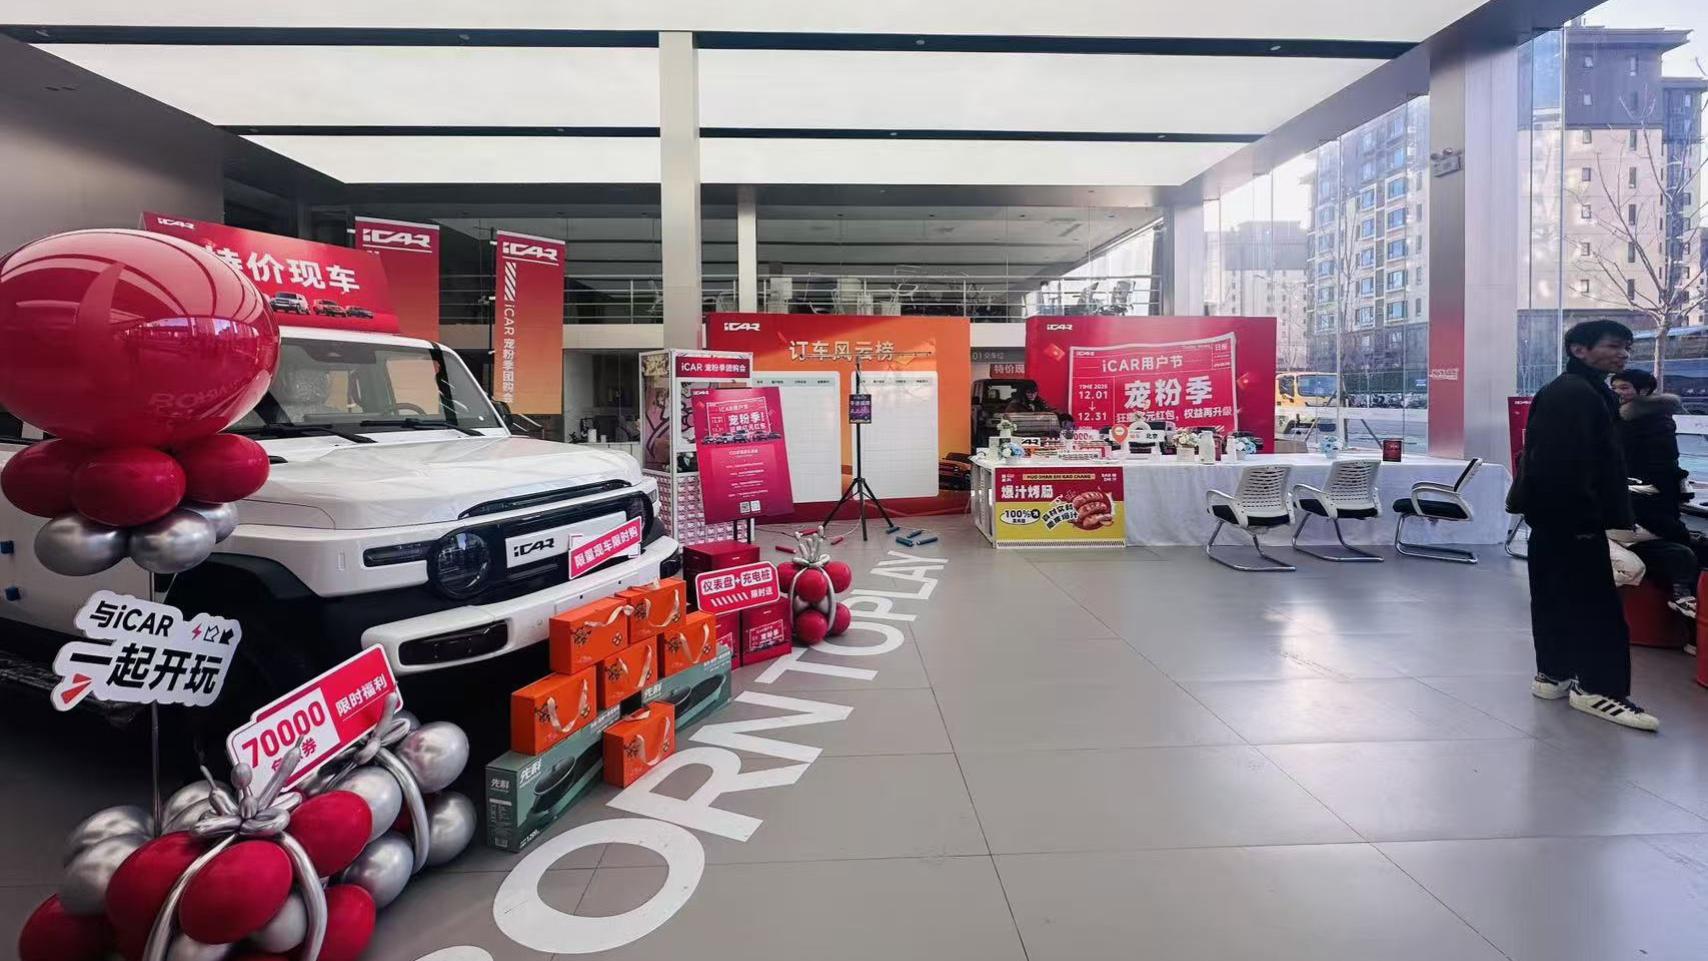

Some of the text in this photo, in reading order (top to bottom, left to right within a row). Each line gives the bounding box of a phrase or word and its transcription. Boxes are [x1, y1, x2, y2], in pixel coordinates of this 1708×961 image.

[157, 217, 195, 230] iCAR
[362, 228, 431, 248] iCAR
[503, 242, 558, 261] iCAR
[724, 322, 761, 332] iCAR
[1046, 323, 1073, 331] iCAR
[789, 340, 895, 361] 订车风云榜
[681, 362, 703, 372] iCAR
[1102, 354, 1184, 373] iCAR用户节
[1078, 390, 1108, 400] 12.01
[1124, 375, 1213, 410] 宠粉季
[1077, 412, 1107, 421] 12.31
[513, 537, 555, 558] iCAR
[573, 524, 638, 569] 限量现车限时购
[90, 600, 174, 637] 与iCAR
[69, 641, 223, 695] 一起开玩
[334, 673, 388, 717] 限时福利
[241, 700, 326, 769] 70000
[415, 690, 853, 961] ORN
